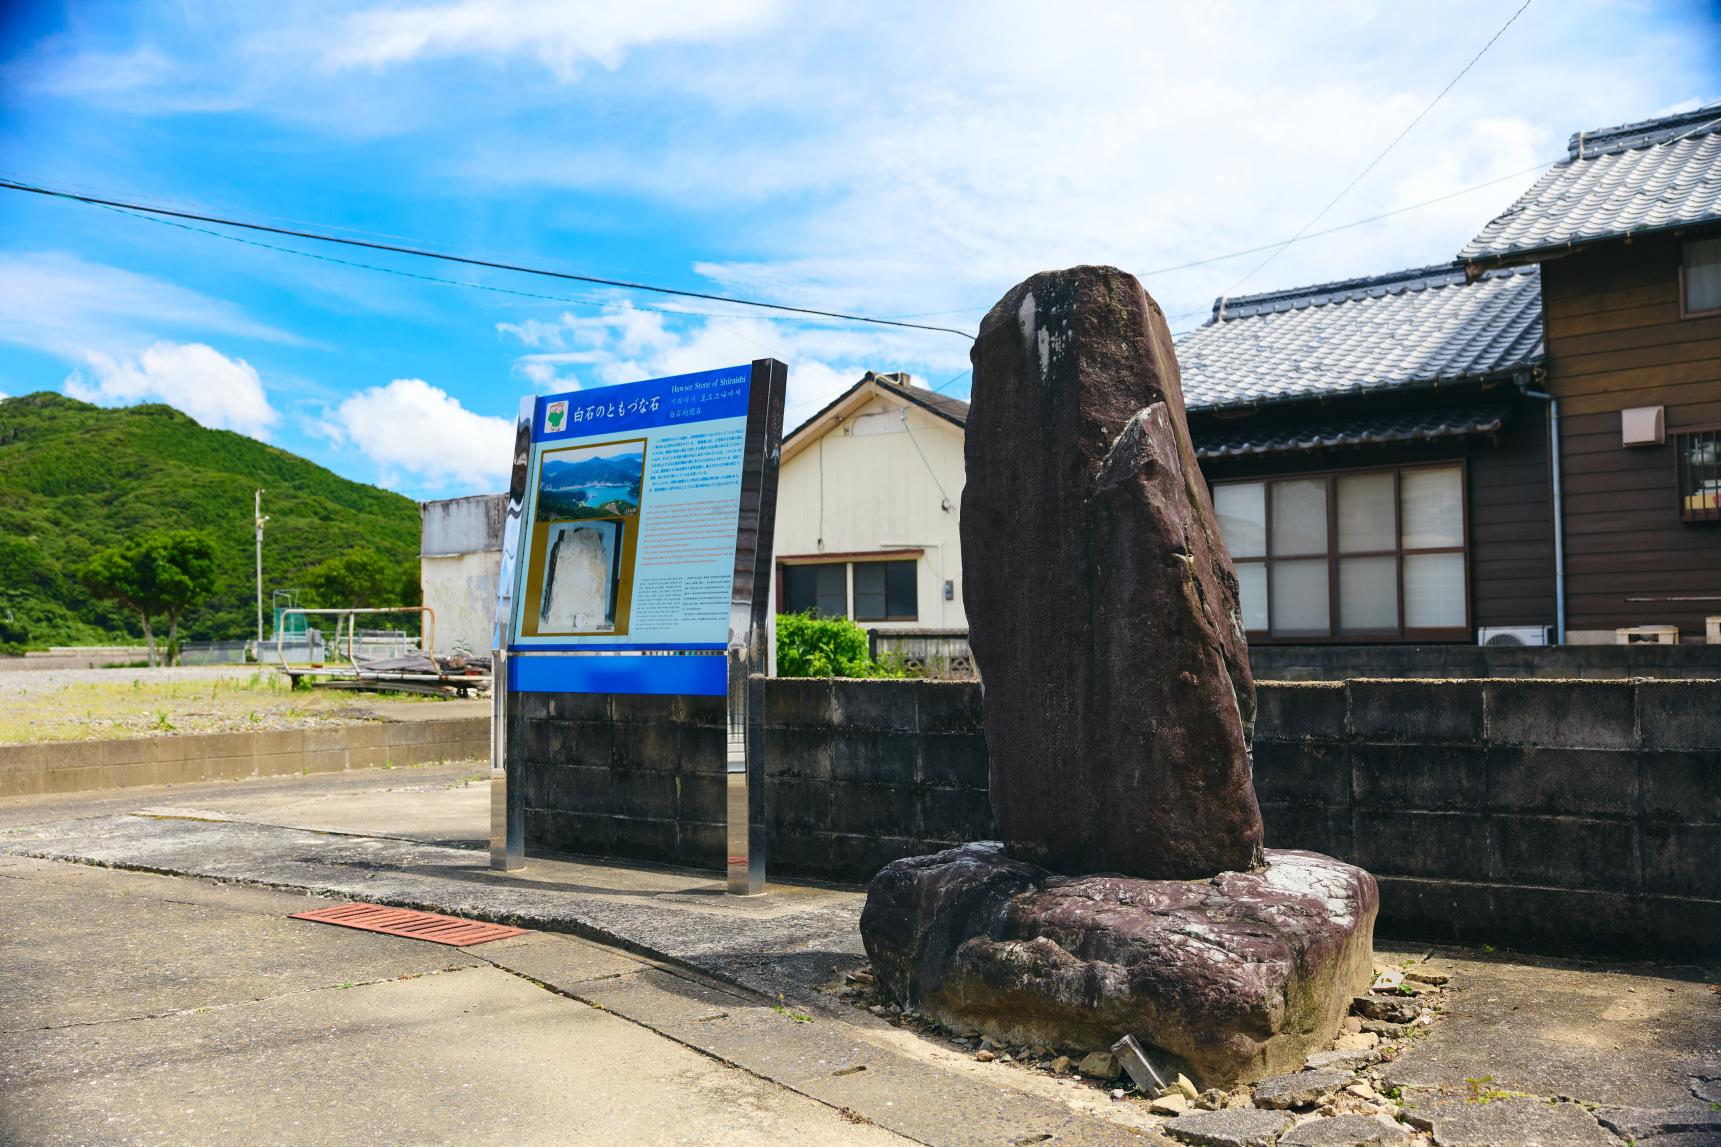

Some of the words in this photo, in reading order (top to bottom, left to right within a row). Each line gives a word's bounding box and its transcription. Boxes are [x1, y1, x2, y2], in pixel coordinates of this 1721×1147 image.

[671, 385, 694, 394] Hawser
[695, 381, 711, 390] Stone
[712, 379, 719, 387] of
[720, 375, 746, 386] Shiraishi
[574, 395, 660, 423] 白石のともづな石
